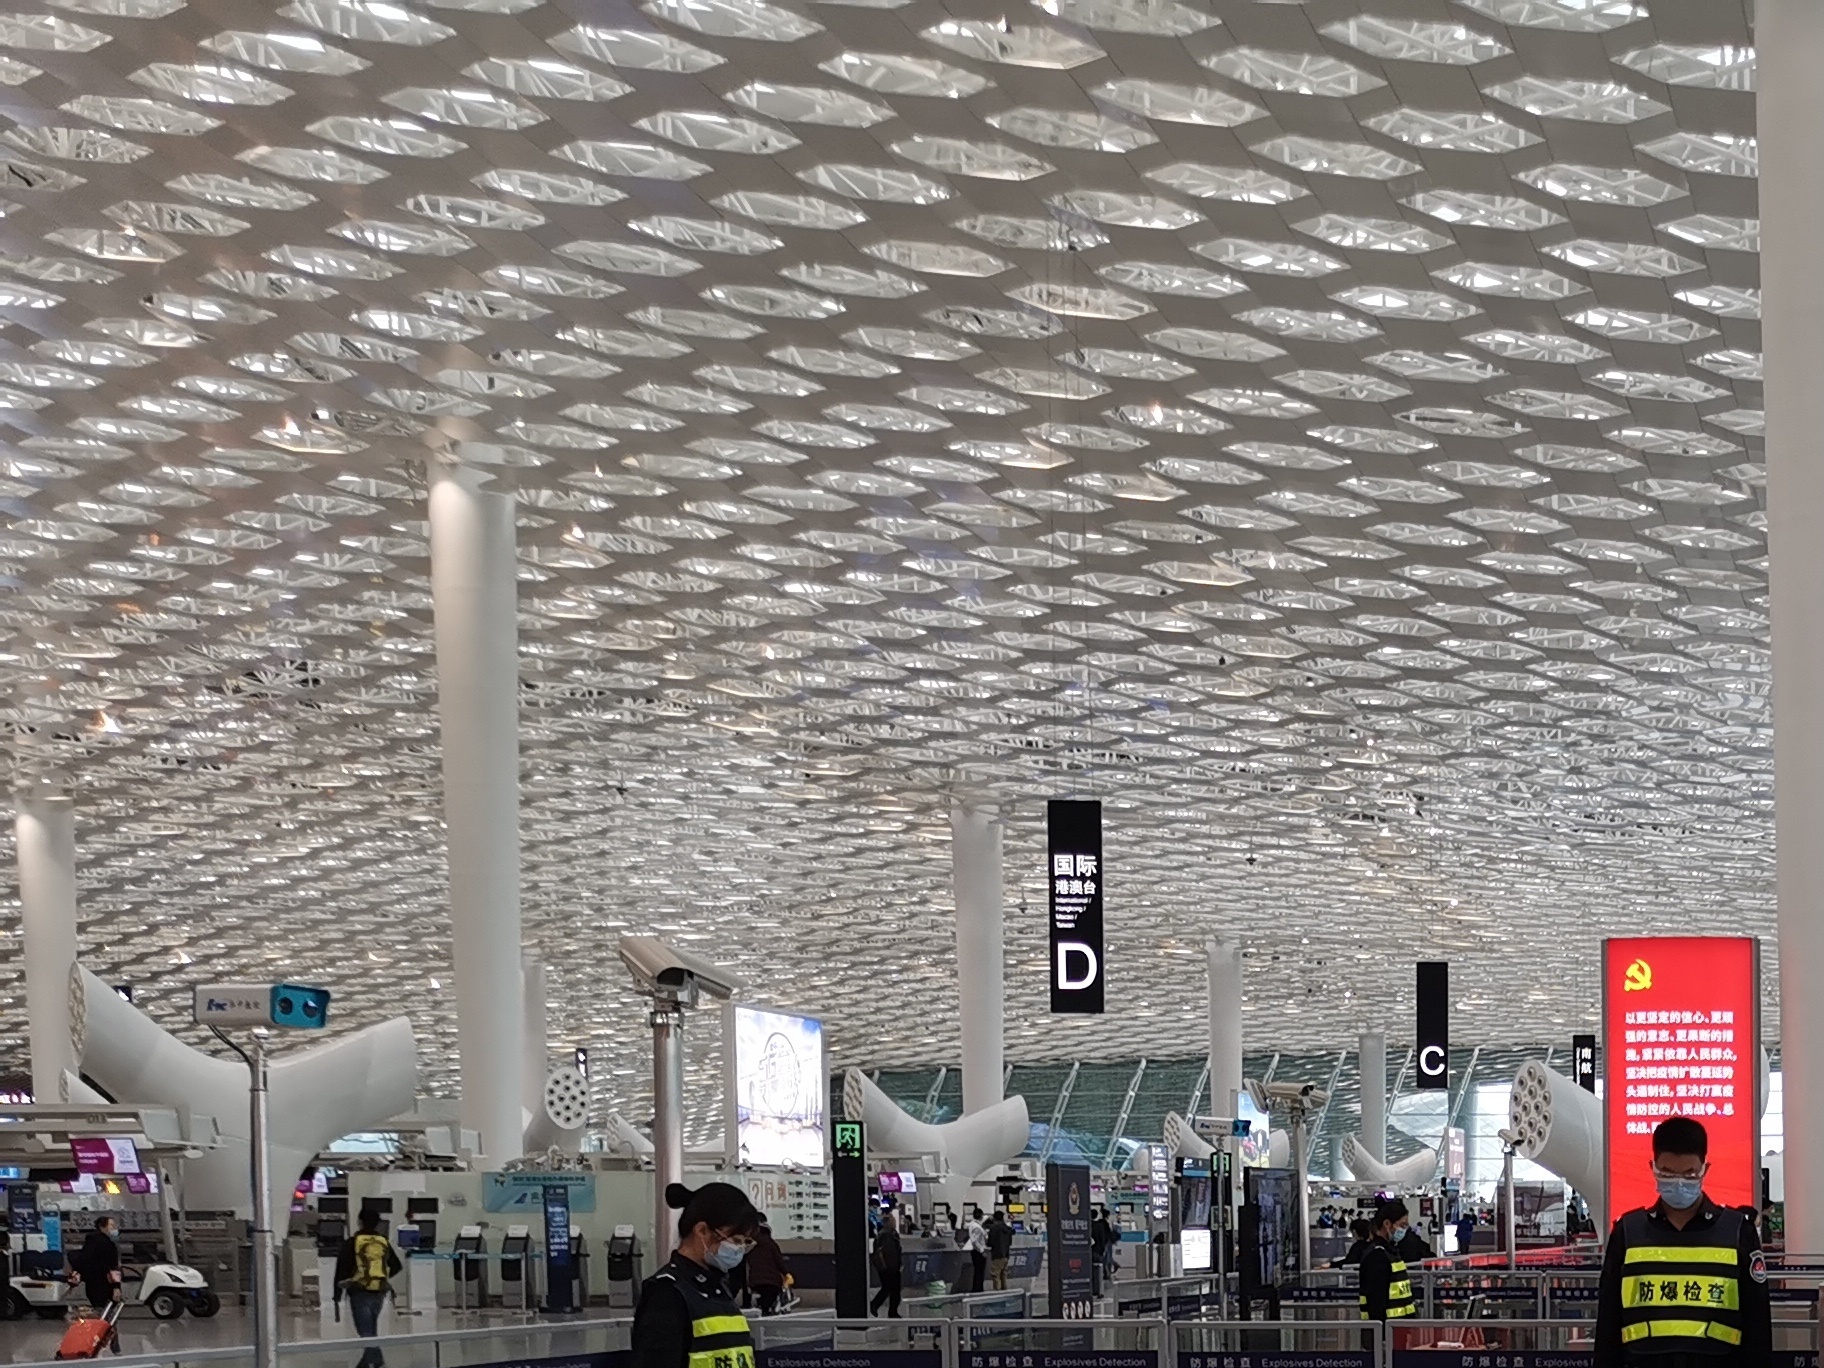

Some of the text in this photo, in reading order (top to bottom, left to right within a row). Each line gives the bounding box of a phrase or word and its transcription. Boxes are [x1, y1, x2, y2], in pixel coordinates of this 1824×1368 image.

[1054, 854, 1097, 877] 国际
[1055, 880, 1096, 895] 港澳台
[1057, 942, 1097, 990] D
[1420, 1045, 1445, 1076] C
[1639, 1281, 1725, 1304] 防爆检查
[767, 1357, 871, 1368] Explosives Detection
[971, 1355, 1034, 1367] 防爆检查
[1044, 1356, 1147, 1368] Explosives Detection
[1190, 1356, 1251, 1368] 防爆检查
[1261, 1357, 1363, 1368] Explosives Detection
[1461, 1355, 1525, 1368] 防爆检查
[1535, 1357, 1588, 1368] Explosives
